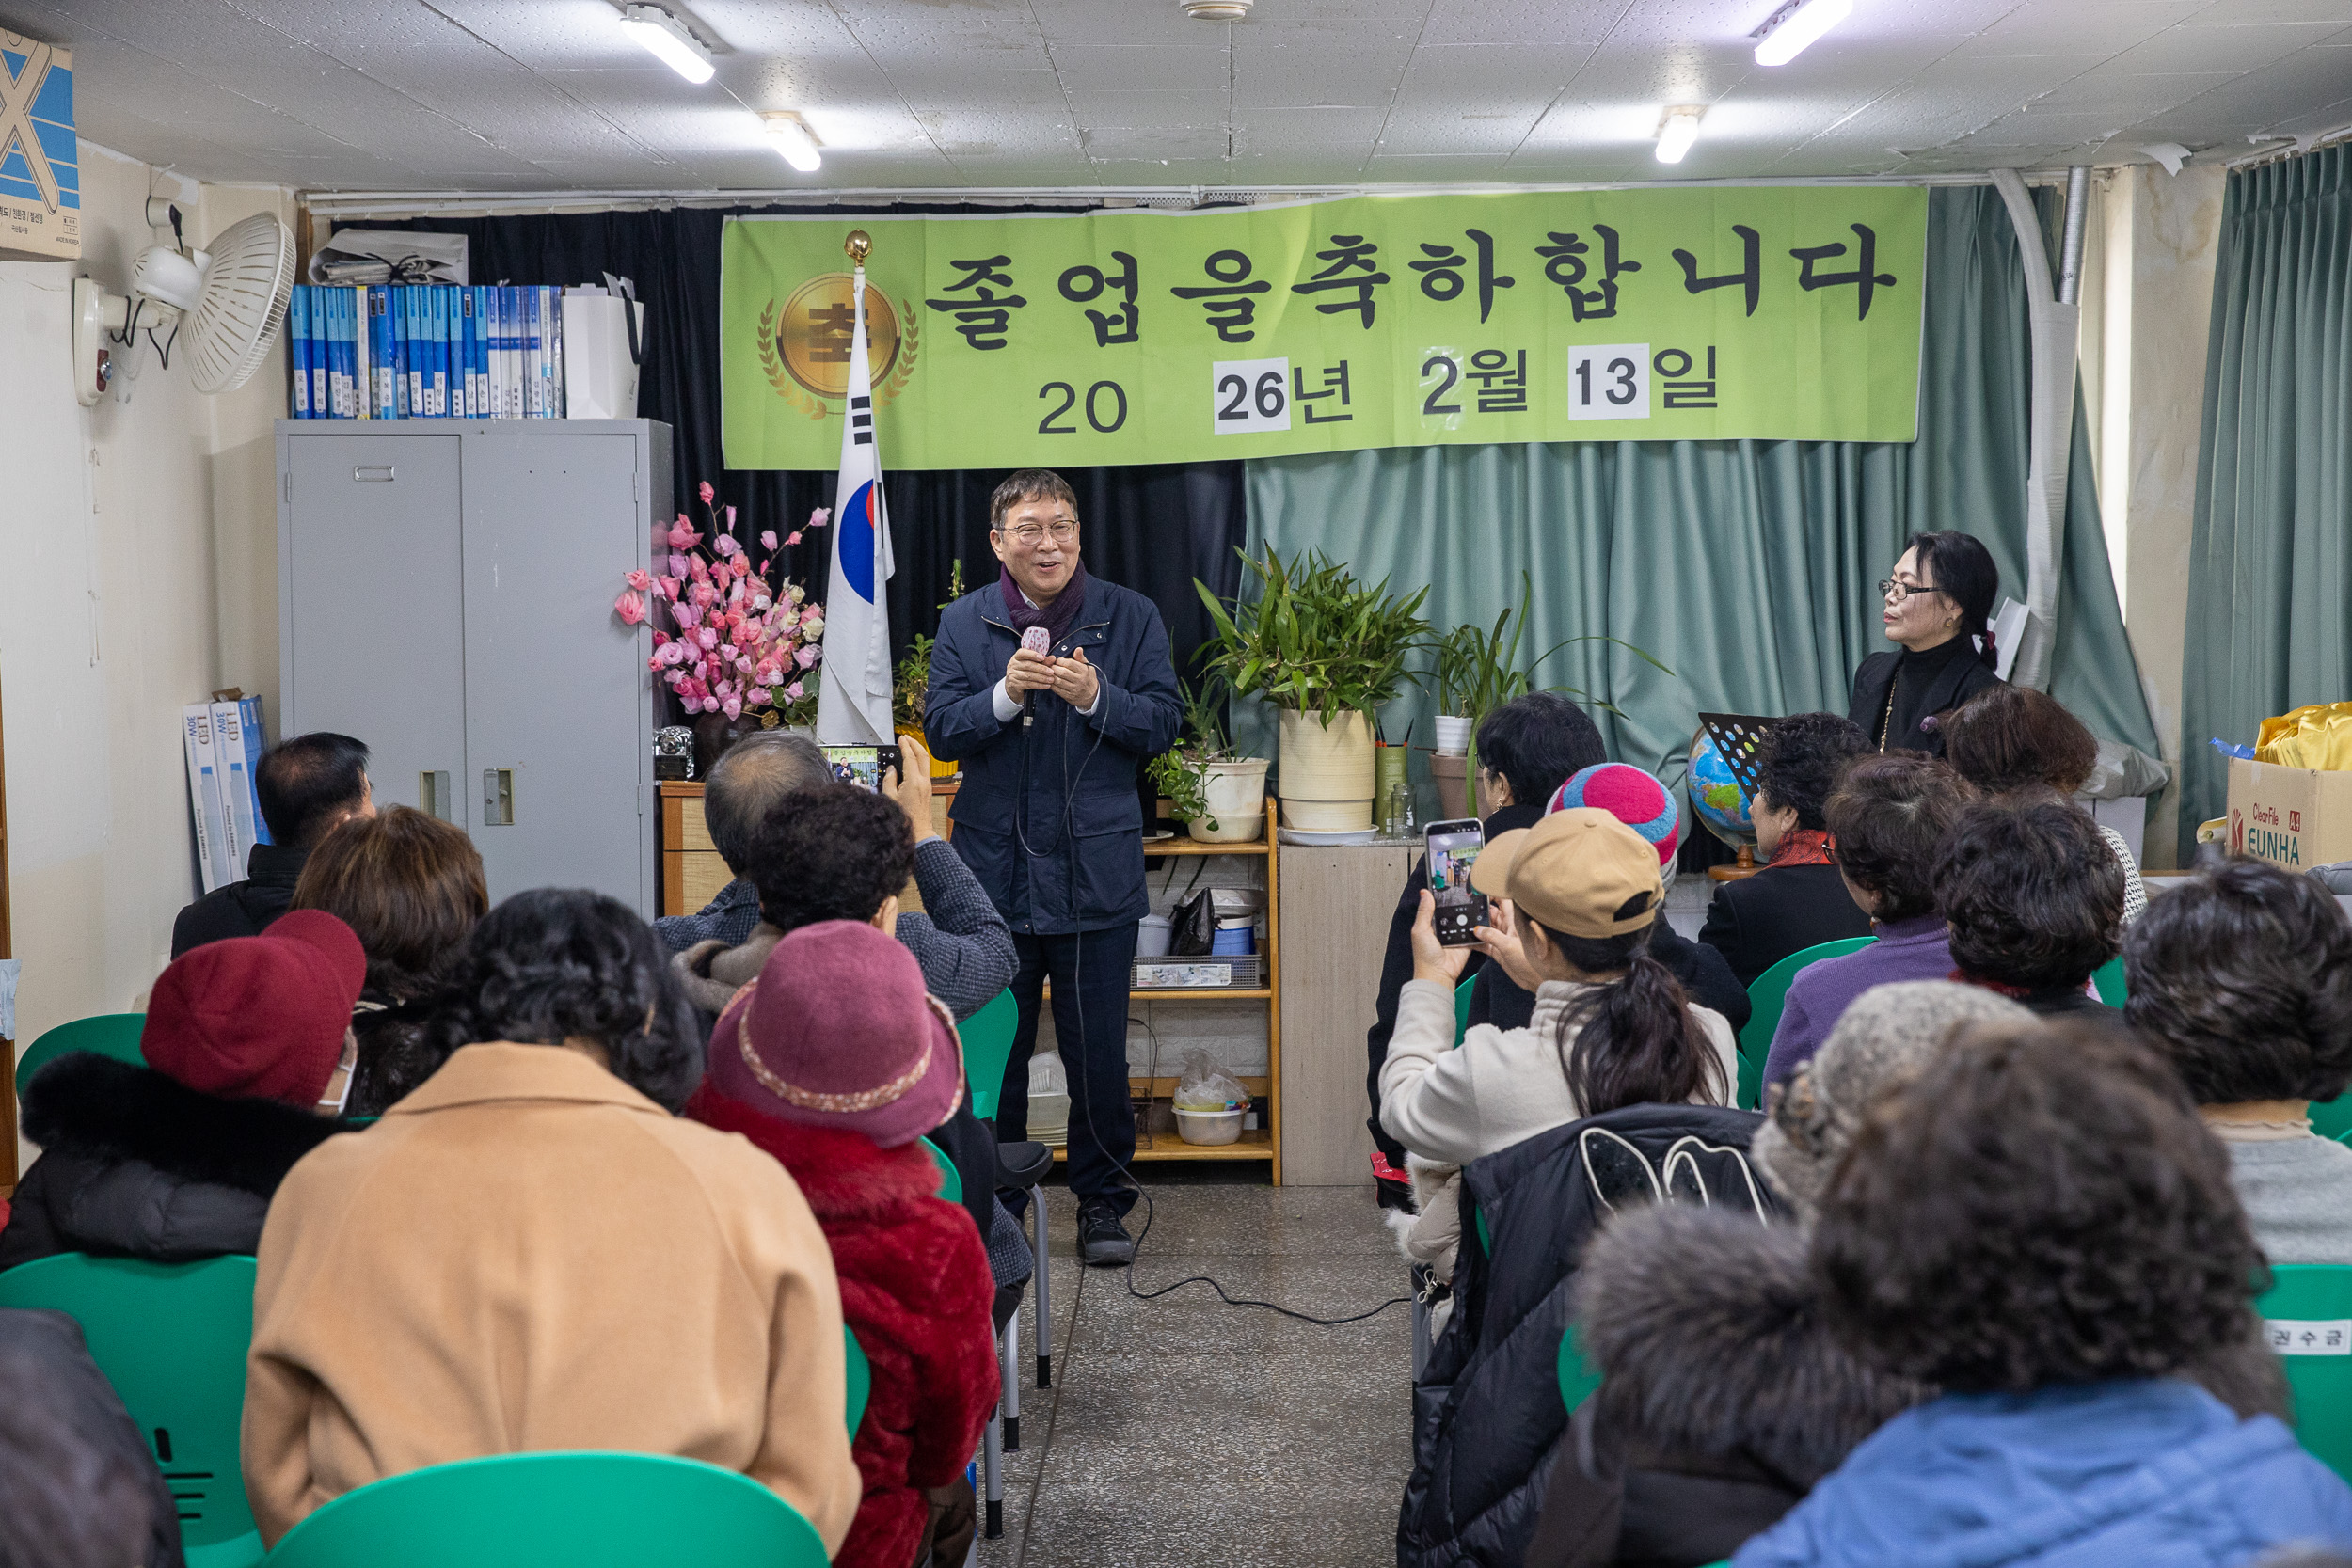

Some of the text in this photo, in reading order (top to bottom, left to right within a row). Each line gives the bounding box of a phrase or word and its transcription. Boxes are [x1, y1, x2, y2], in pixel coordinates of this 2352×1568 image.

[1038, 380, 1128, 434] 20
[1421, 347, 1528, 415] 2월
[186, 716, 197, 737] 30W
[197, 716, 209, 745] LED
[215, 712, 227, 734] 30W
[227, 712, 238, 741] LED
[2290, 812, 2300, 832] A4
[2248, 827, 2300, 867] EUNHA
